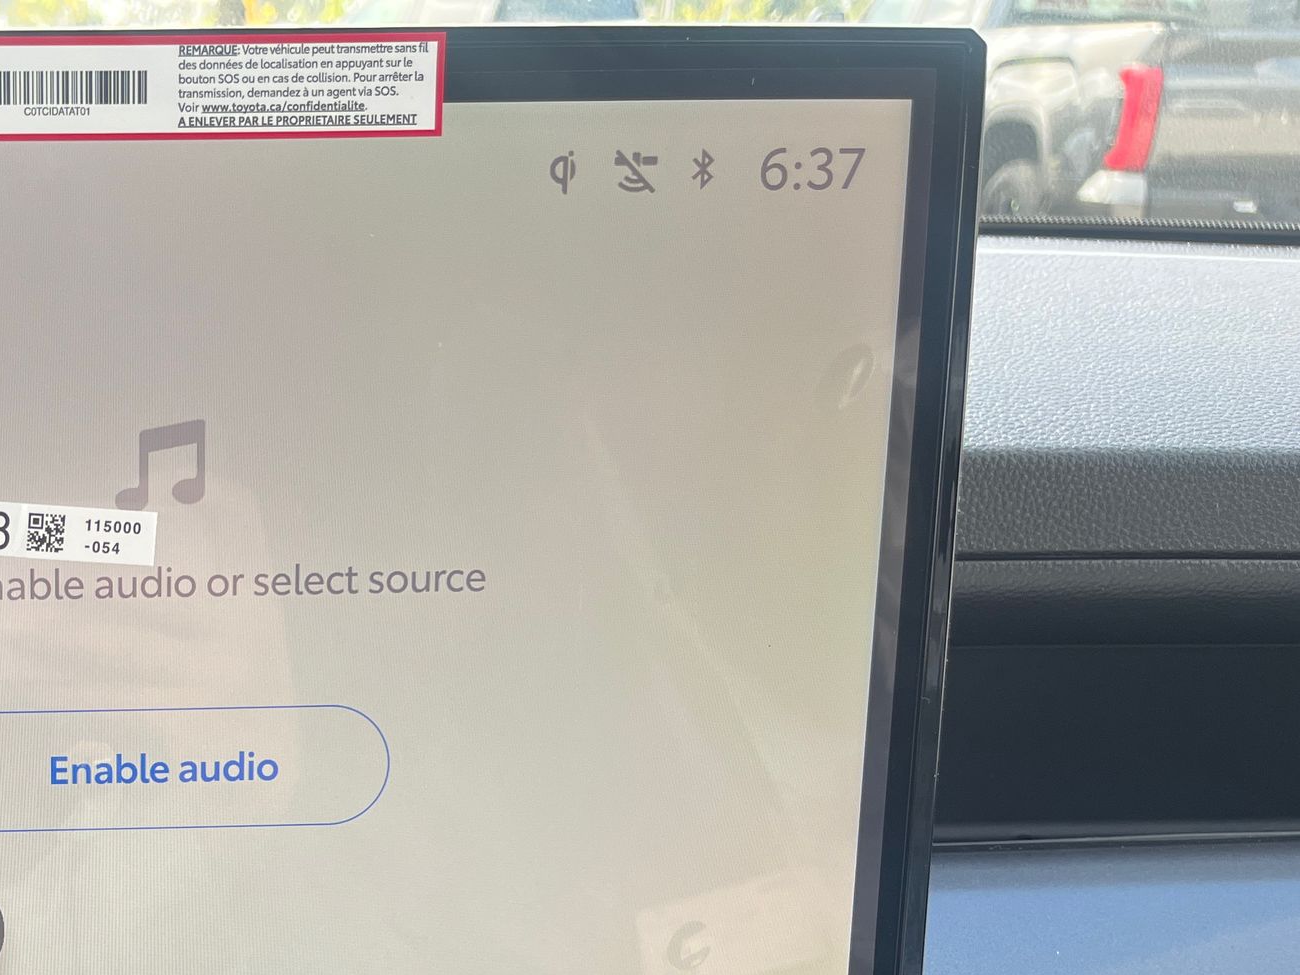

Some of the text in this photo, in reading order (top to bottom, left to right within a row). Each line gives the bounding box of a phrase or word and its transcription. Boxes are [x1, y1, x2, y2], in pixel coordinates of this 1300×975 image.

[178, 42, 429, 57] REMARQUE: Votre véhicule peut transmettre sans fil
[178, 60, 197, 70] des
[199, 60, 243, 70] données
[245, 59, 258, 69] de
[261, 58, 318, 69] localisation
[335, 58, 384, 70] appuyant
[386, 59, 402, 68] sur
[403, 57, 413, 67] le
[178, 71, 424, 84] bouton SOS ou en cas de collision. Pour arrêter la
[178, 86, 399, 99] transmission, demandez à un agent via SOS.
[178, 100, 368, 113] Voir www.toyota.ca/confidentialite.
[178, 113, 418, 128] A ENLEVER PAR LE PROPRIETAIRE SEULEMENT
[760, 147, 867, 191] 6:37
[85, 519, 141, 534] 115000
[84, 541, 120, 554] -054
[94, 565, 197, 599] audio
[206, 575, 245, 597] or
[253, 563, 359, 596] select
[367, 567, 487, 595] source
[49, 751, 279, 785] Enable audio
